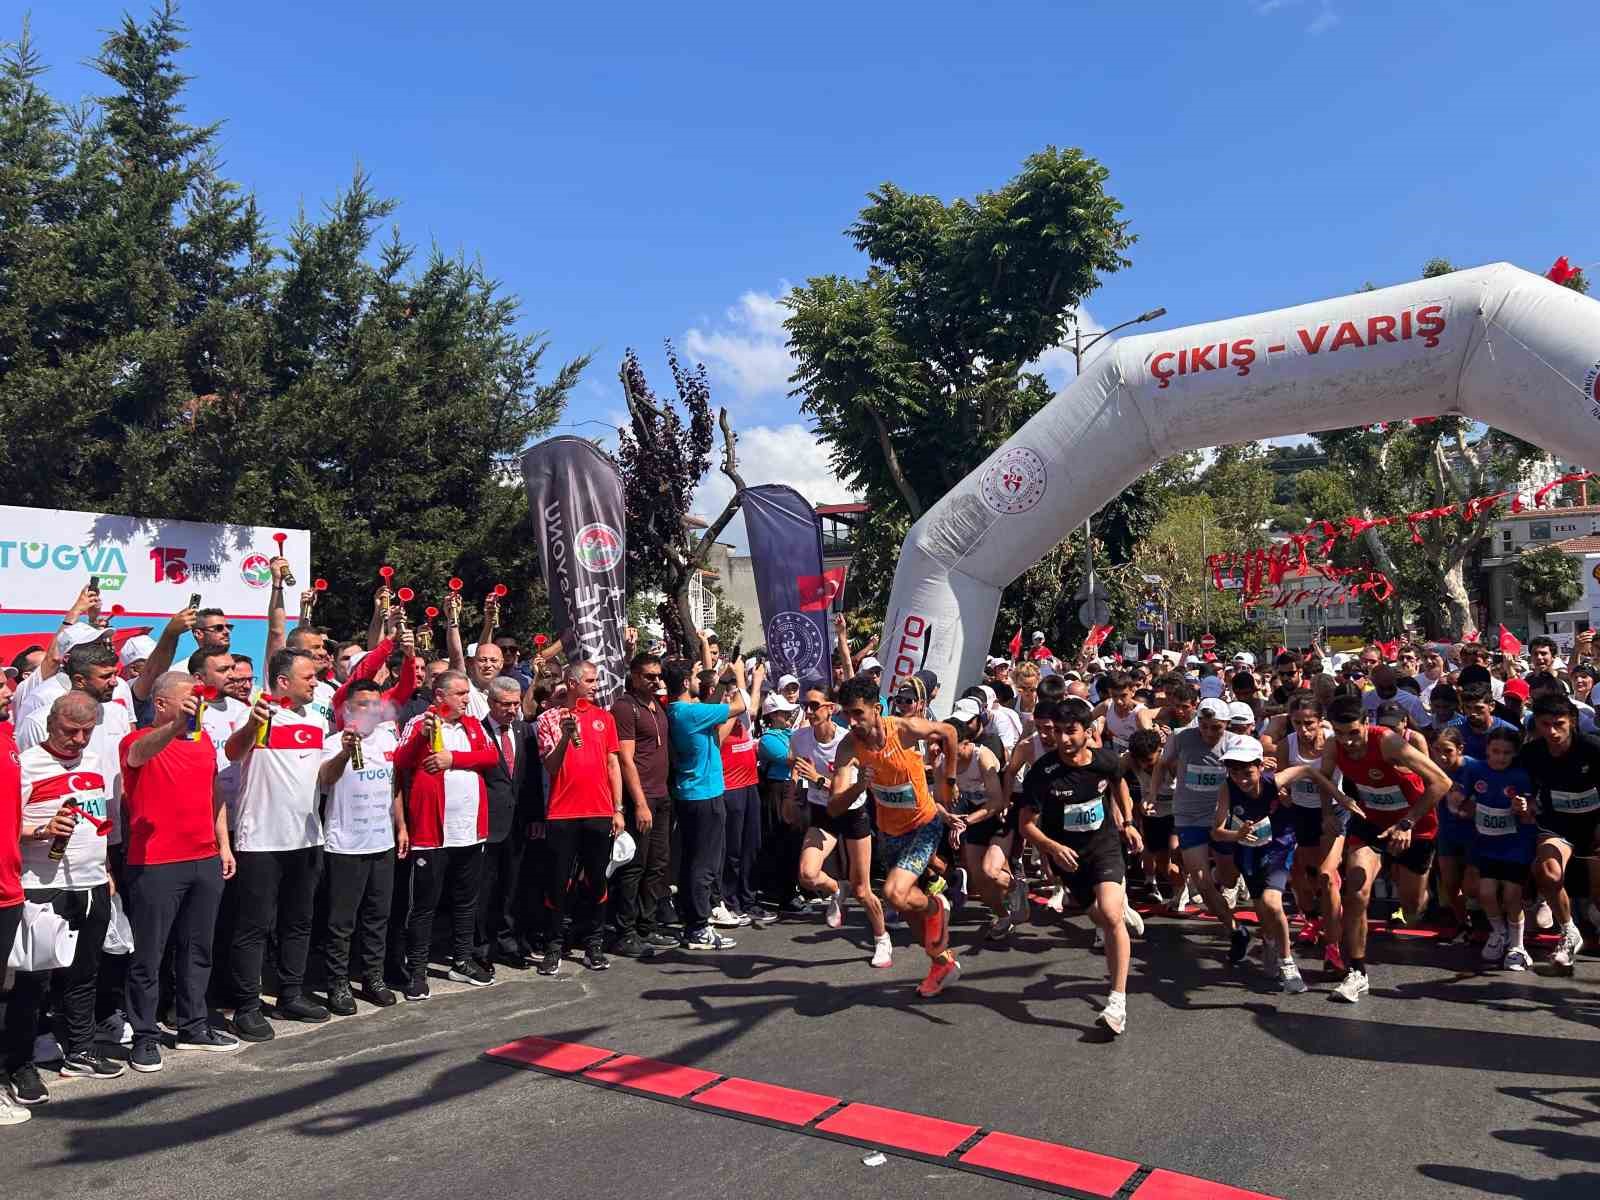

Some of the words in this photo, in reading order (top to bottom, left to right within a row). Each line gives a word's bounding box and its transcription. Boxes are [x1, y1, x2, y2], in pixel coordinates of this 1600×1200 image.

[1149, 338, 1257, 389] ÇIKIŞ
[1296, 304, 1447, 349] VARIŞ
[100, 578, 121, 587] POR
[357, 769, 393, 781] TÜGV
[1196, 773, 1217, 785] 155
[76, 799, 101, 819] 741
[1074, 807, 1097, 825] 405
